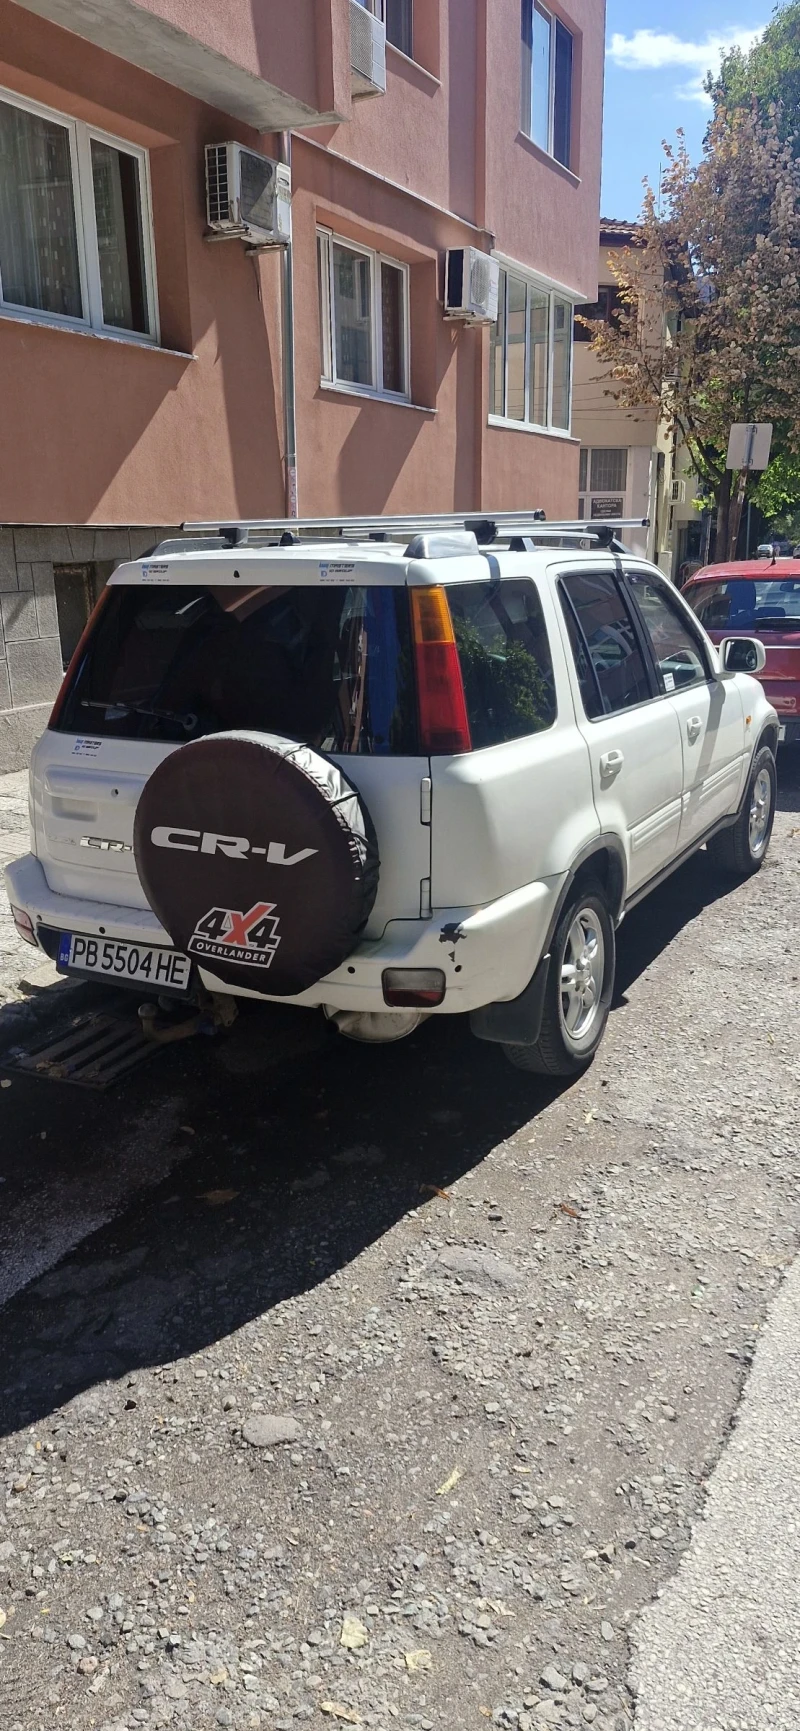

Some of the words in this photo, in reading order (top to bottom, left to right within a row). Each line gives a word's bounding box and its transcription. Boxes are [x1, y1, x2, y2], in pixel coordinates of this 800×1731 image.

[80, 835, 133, 853] CR-
[151, 826, 319, 866] CR-V
[60, 952, 69, 962] BG
[196, 942, 266, 962] OVERLANDER
